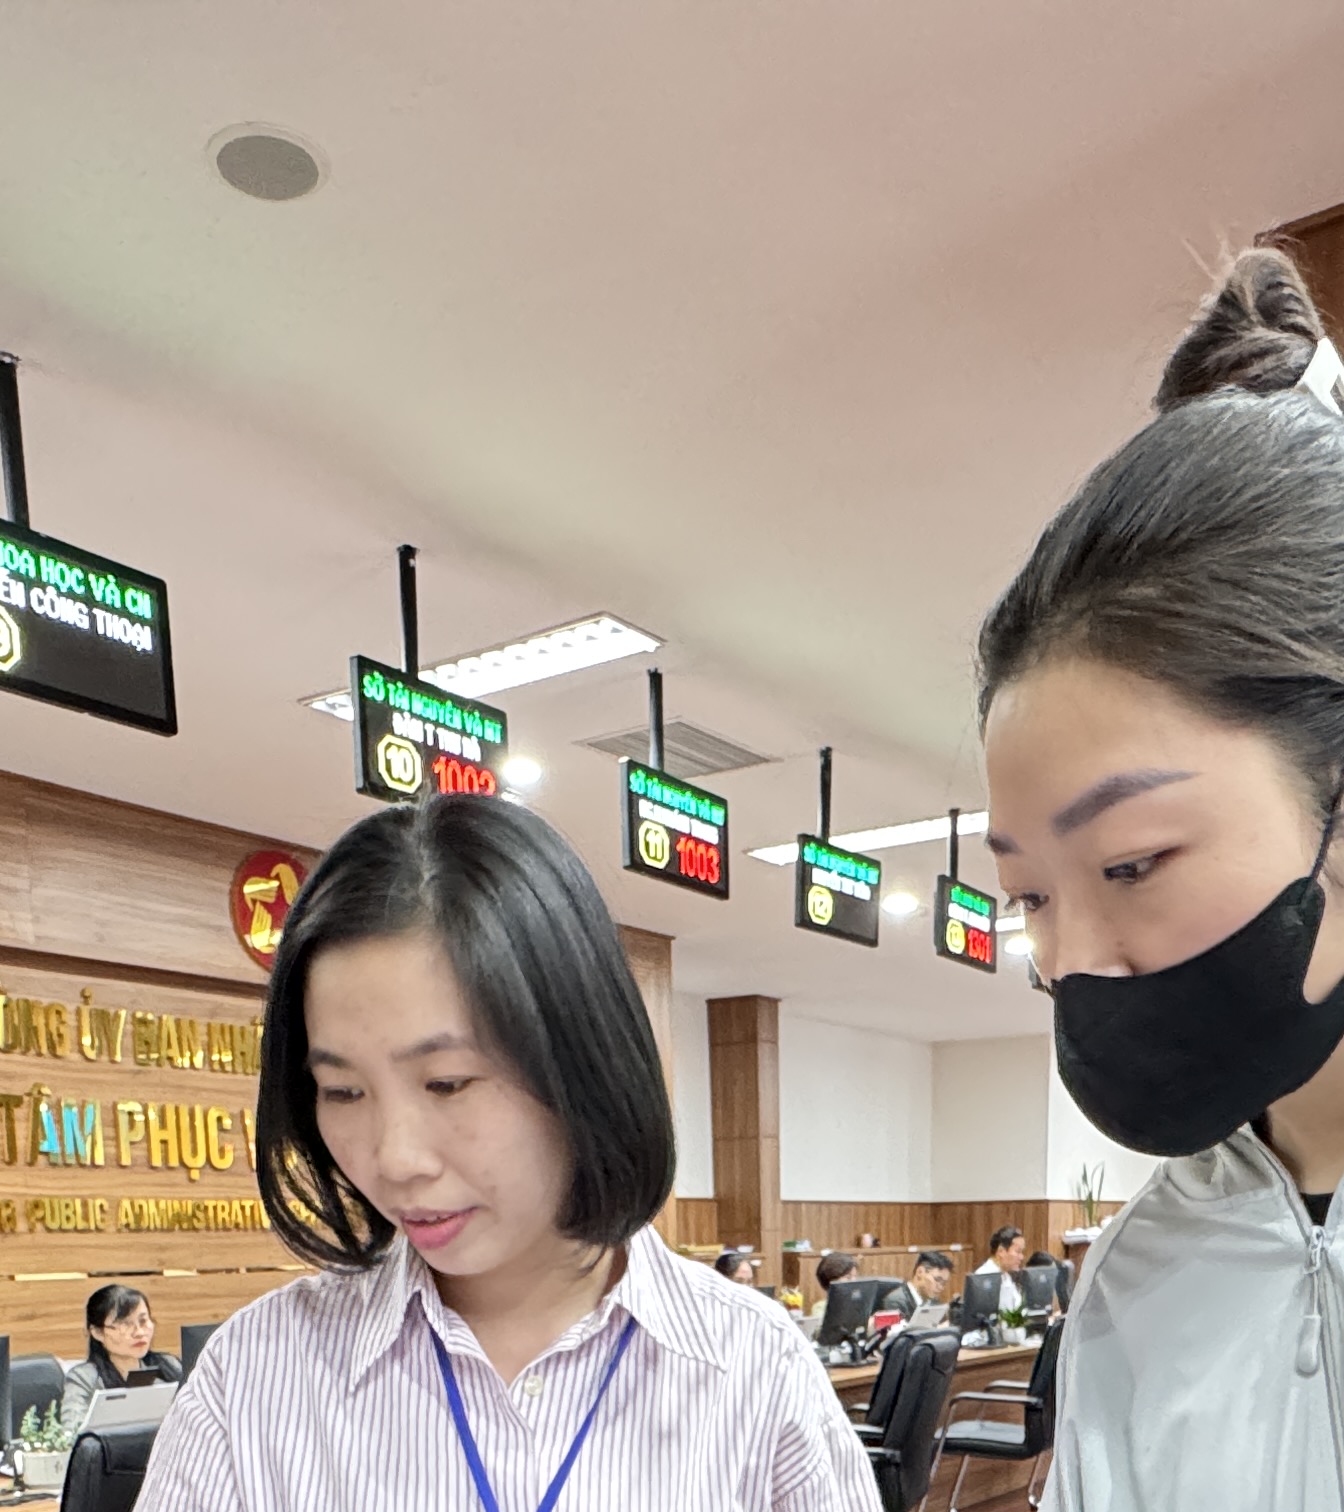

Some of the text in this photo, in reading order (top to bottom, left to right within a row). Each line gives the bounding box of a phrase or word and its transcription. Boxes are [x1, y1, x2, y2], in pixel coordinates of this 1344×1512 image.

[29, 586, 89, 630] CÔNG
[40, 555, 85, 594] HỌC
[89, 574, 121, 609] VÀ
[125, 588, 152, 618] CN
[363, 671, 385, 700] SỞ
[387, 682, 409, 711] TÀI
[463, 710, 483, 737] VÀ
[386, 745, 414, 782] 10
[646, 829, 663, 861] 11
[676, 836, 719, 883] 1003
[77, 986, 127, 1063] ỦY
[133, 1010, 204, 1069] BAN
[114, 1100, 234, 1181] PHỤC
[25, 1198, 107, 1233] PUBLIC
